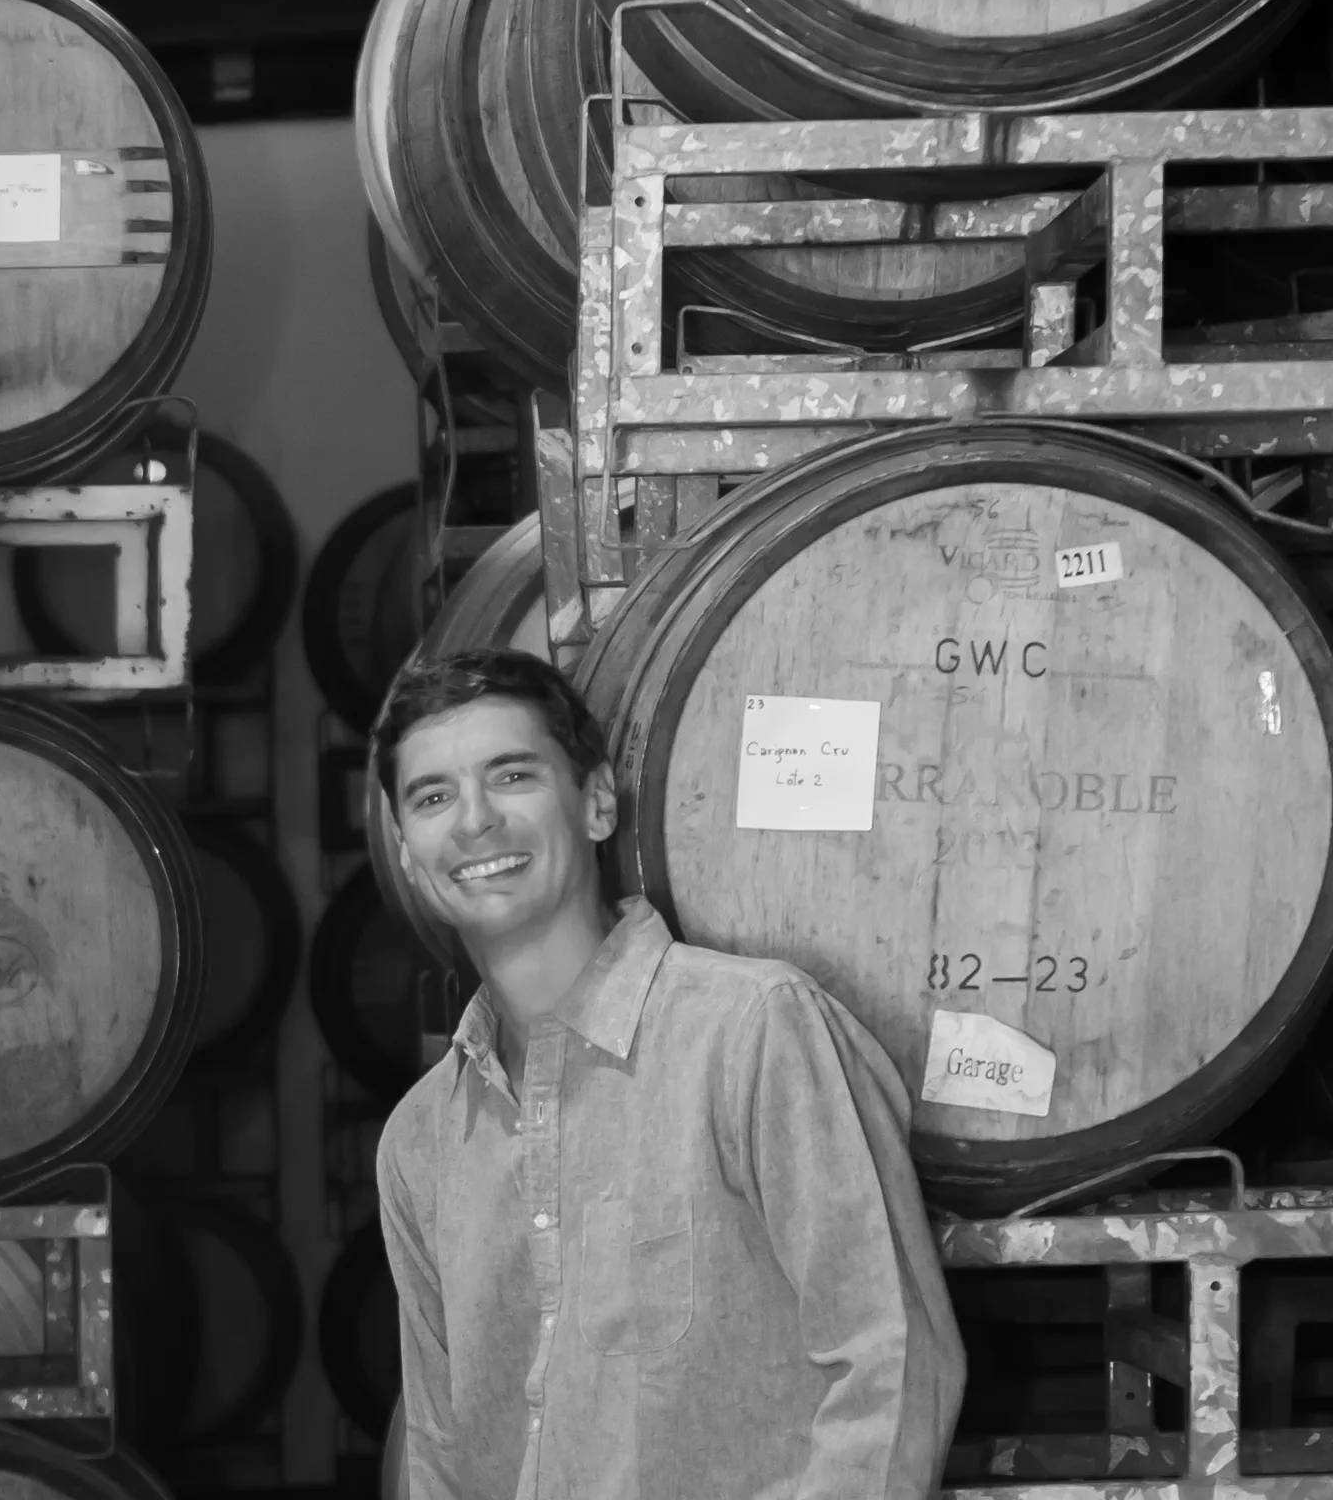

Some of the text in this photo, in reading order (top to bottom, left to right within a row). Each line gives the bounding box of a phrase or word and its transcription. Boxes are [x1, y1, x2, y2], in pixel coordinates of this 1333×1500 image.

[1061, 550, 1107, 578] 2211
[936, 637, 1048, 678] GWC
[747, 698, 765, 710] 23
[745, 741, 807, 764] Carignan
[814, 774, 823, 787] 2
[928, 953, 1088, 993] 82-23
[946, 1047, 1024, 1086] Garage
